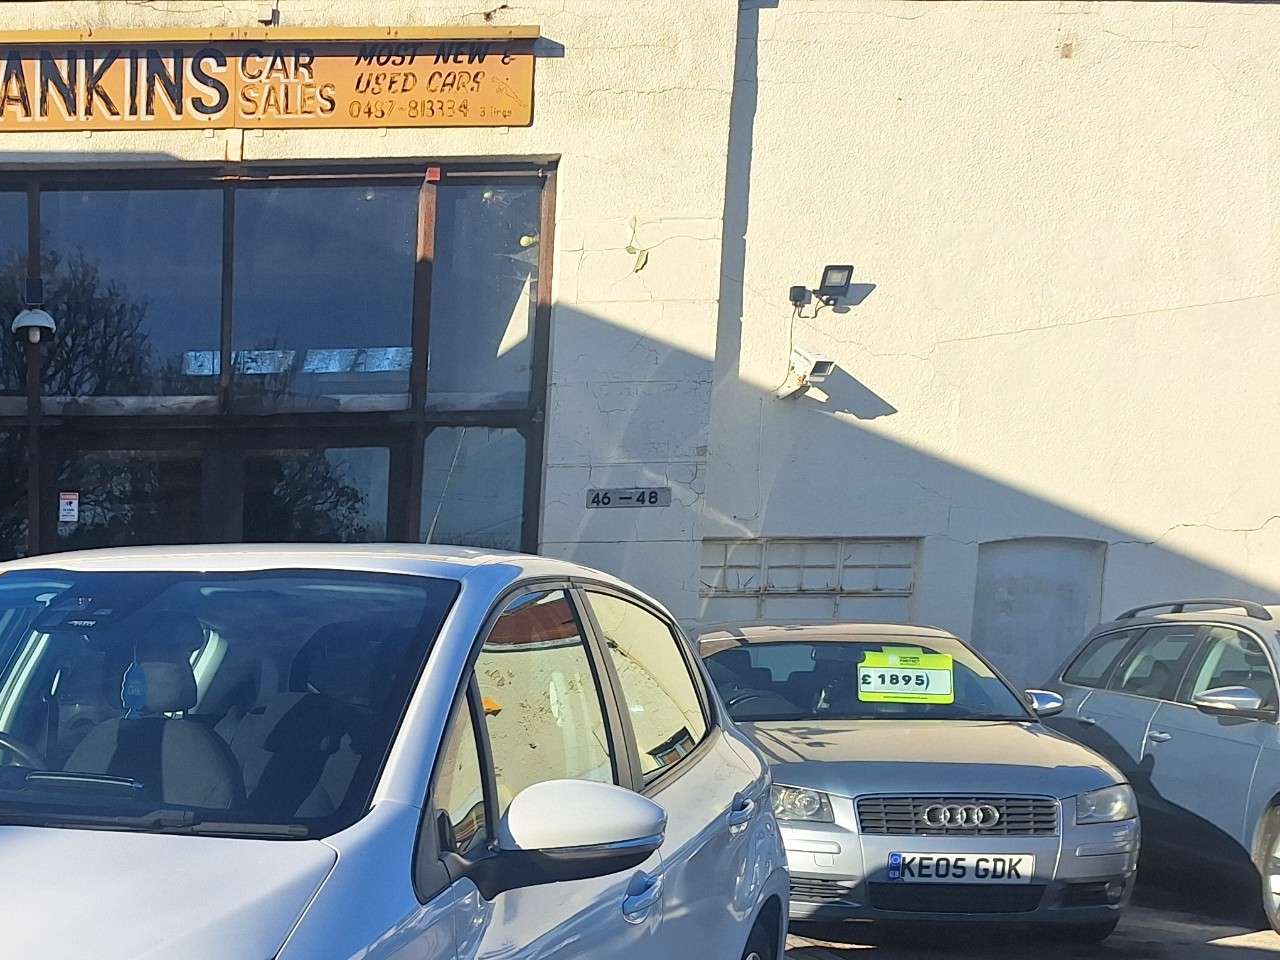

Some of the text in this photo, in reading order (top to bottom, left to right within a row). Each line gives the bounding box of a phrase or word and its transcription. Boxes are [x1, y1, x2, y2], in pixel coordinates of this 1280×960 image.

[240, 47, 315, 80] CAR
[354, 43, 421, 66] MOST
[433, 43, 491, 65] NEW
[354, 71, 486, 95] USED CARS
[240, 83, 337, 115] SALES
[591, 492, 611, 507] 46
[636, 490, 659, 505] 48
[901, 856, 1023, 879] KE05 GDK
